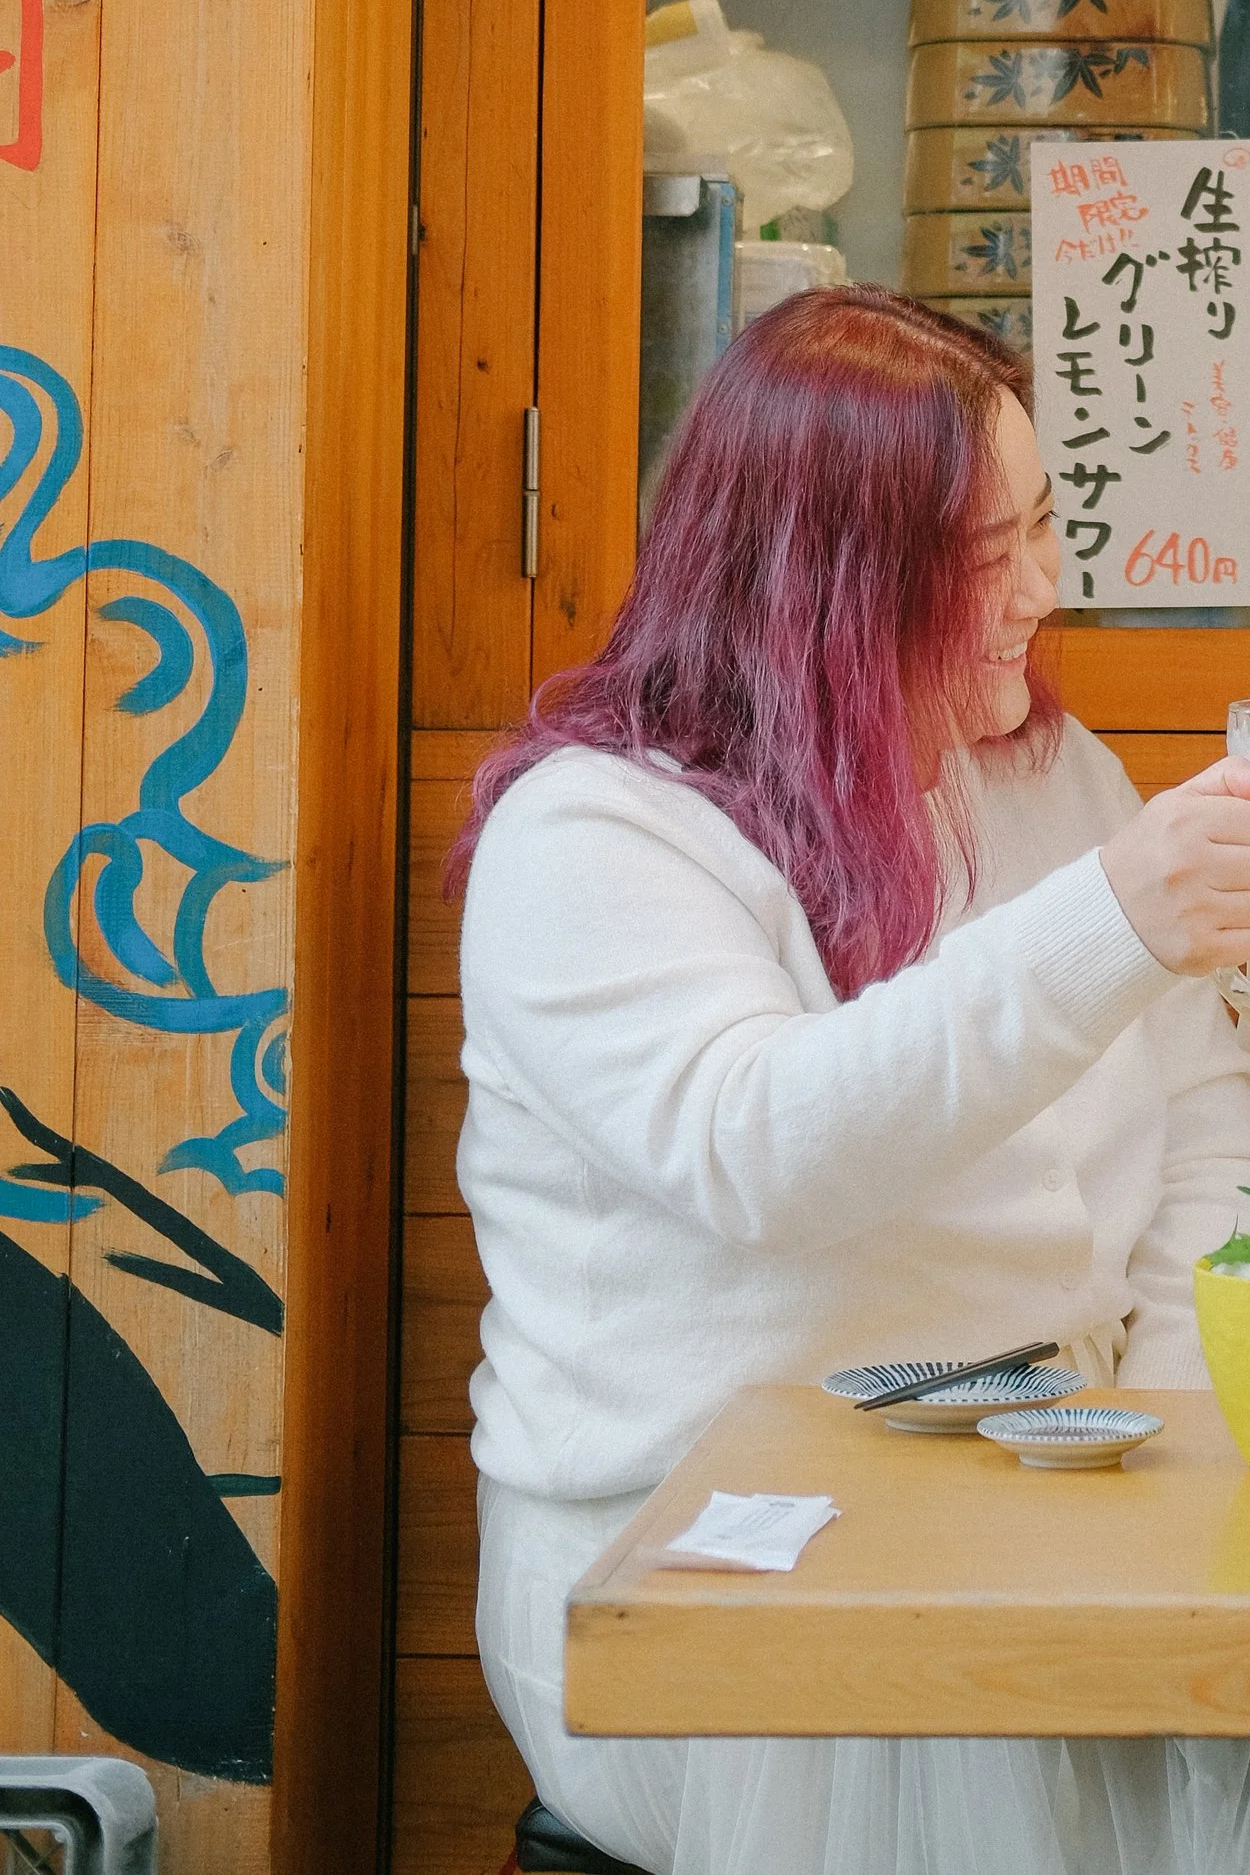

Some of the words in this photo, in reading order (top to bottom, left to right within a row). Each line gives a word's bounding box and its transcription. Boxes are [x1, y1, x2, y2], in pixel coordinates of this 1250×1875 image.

[1048, 156, 1128, 197] 期間
[1077, 191, 1150, 233] 限定
[1176, 166, 1242, 340] 生搾り
[1102, 250, 1172, 455] グリーン
[1055, 296, 1122, 599] レモンサワー
[1123, 528, 1238, 586] 640円
